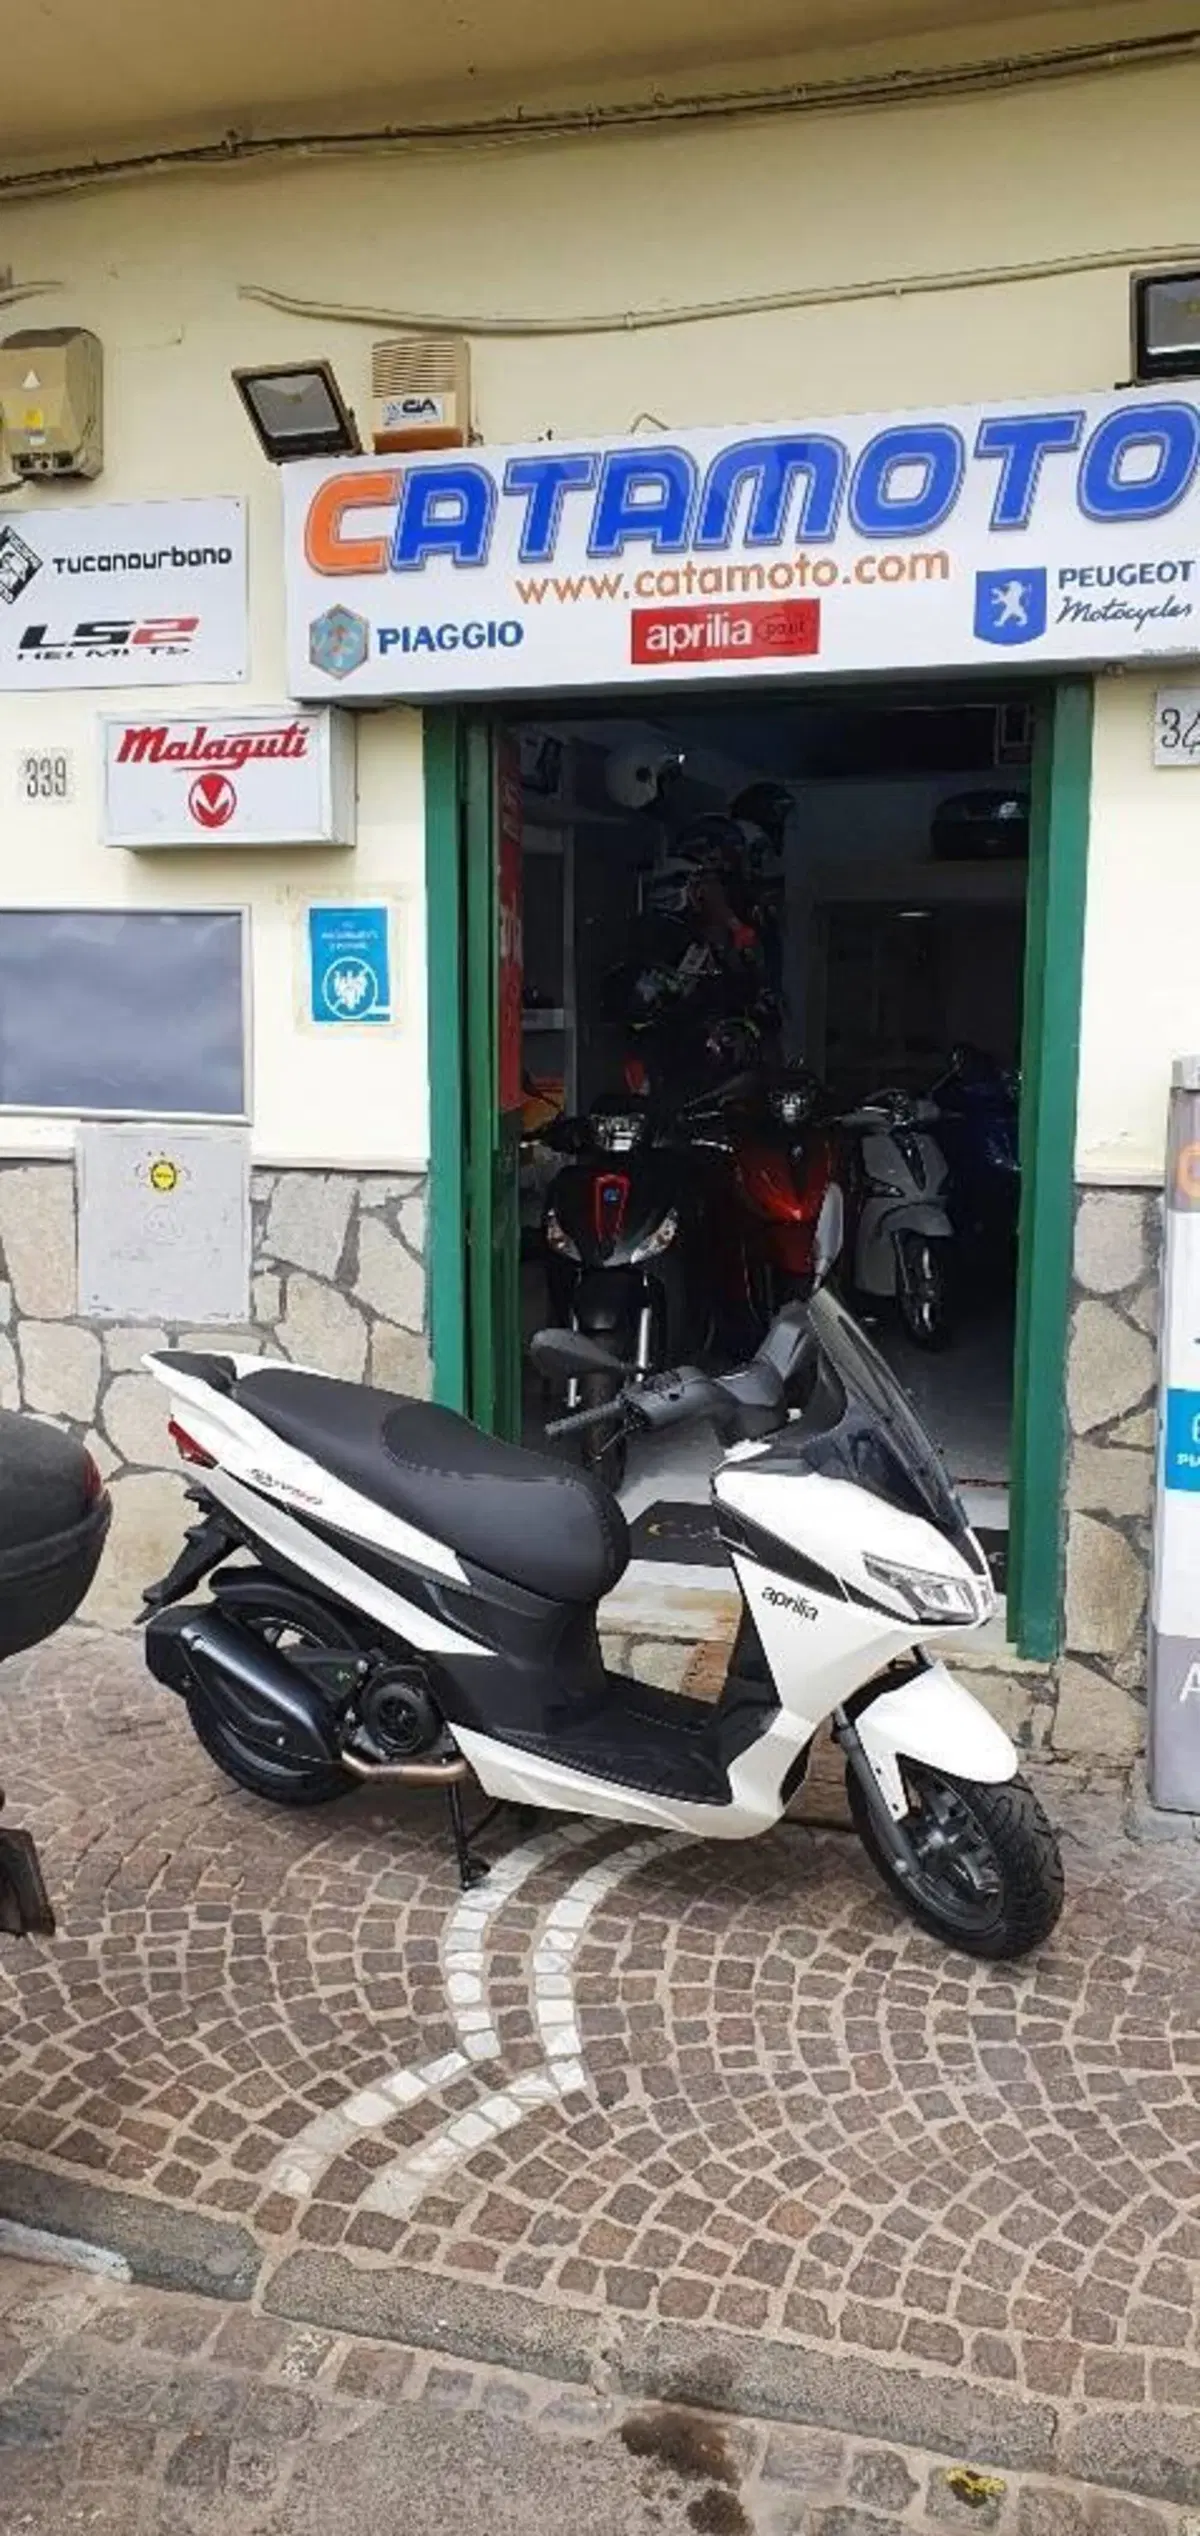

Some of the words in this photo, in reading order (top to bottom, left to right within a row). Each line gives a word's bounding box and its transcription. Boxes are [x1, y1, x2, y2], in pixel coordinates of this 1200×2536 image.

[304, 401, 1200, 577] CATAMOTO
[515, 549, 950, 604] www.catamoto.com
[1058, 560, 1195, 589] PEUGEOT
[19, 617, 200, 649] LS2
[1055, 594, 1192, 632] Motocycles
[377, 620, 524, 654] PIAGGIO
[646, 612, 753, 656] aprilia
[116, 721, 310, 770] Malaguti
[26, 757, 67, 798] 339
